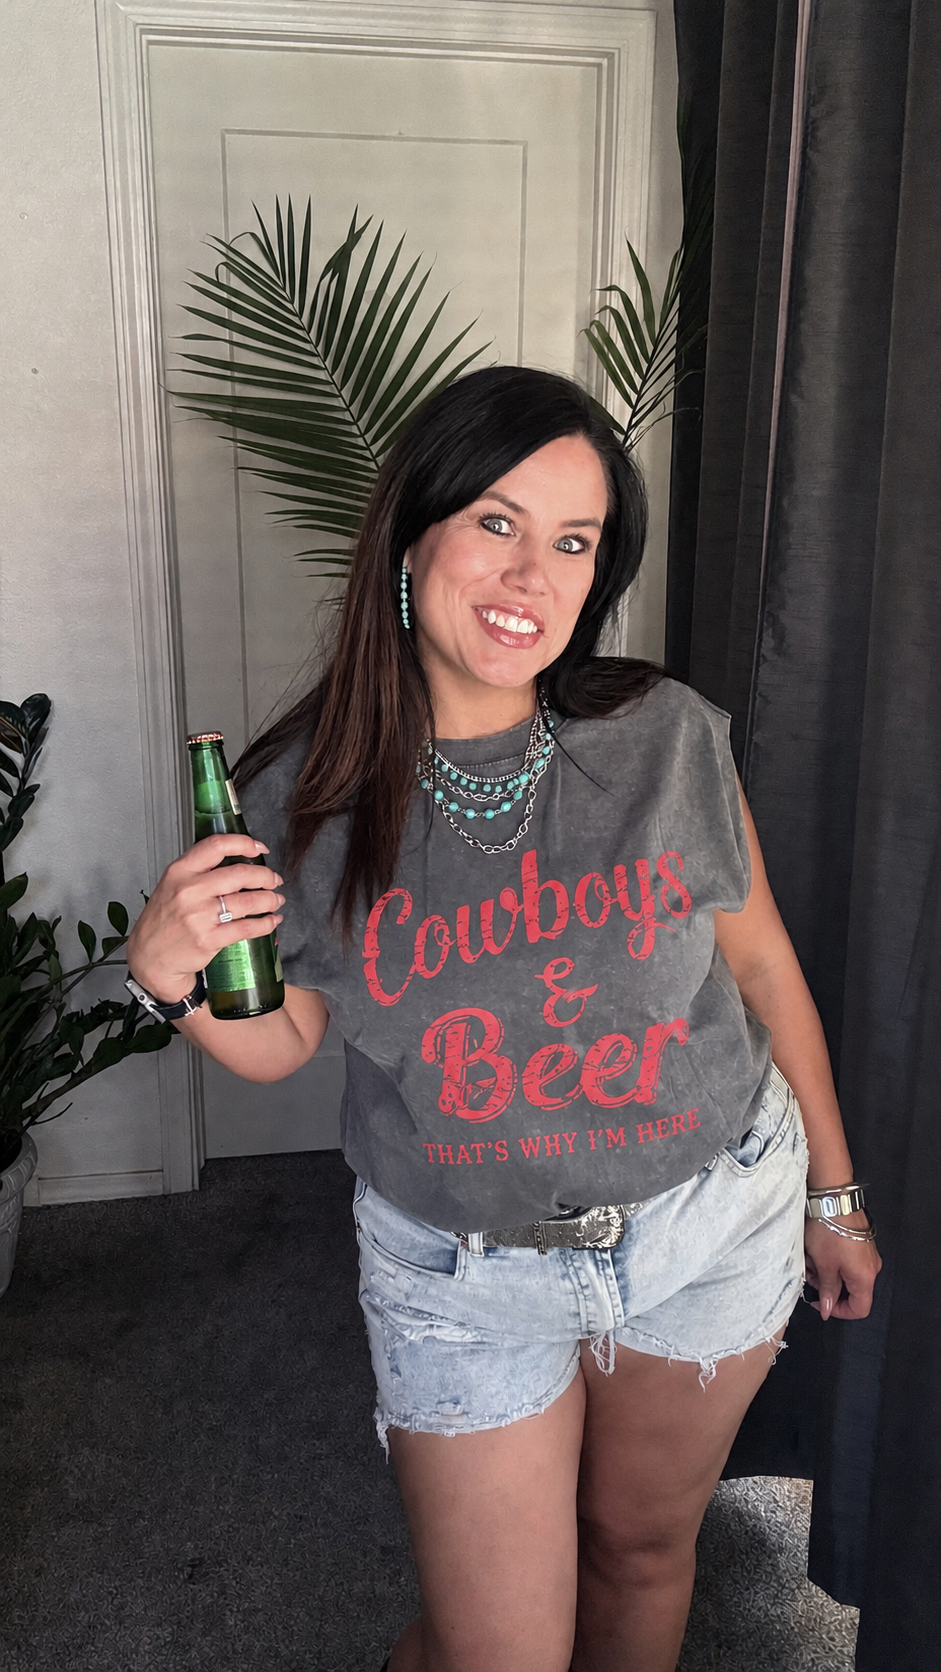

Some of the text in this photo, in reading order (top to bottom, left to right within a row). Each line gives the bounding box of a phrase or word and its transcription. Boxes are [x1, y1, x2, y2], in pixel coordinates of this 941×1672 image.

[362, 849, 692, 1007] Cowboys
[534, 957, 599, 1028] &
[421, 1007, 690, 1124] Beer
[422, 1107, 702, 1165] THAT'S WHY I'M HERE
